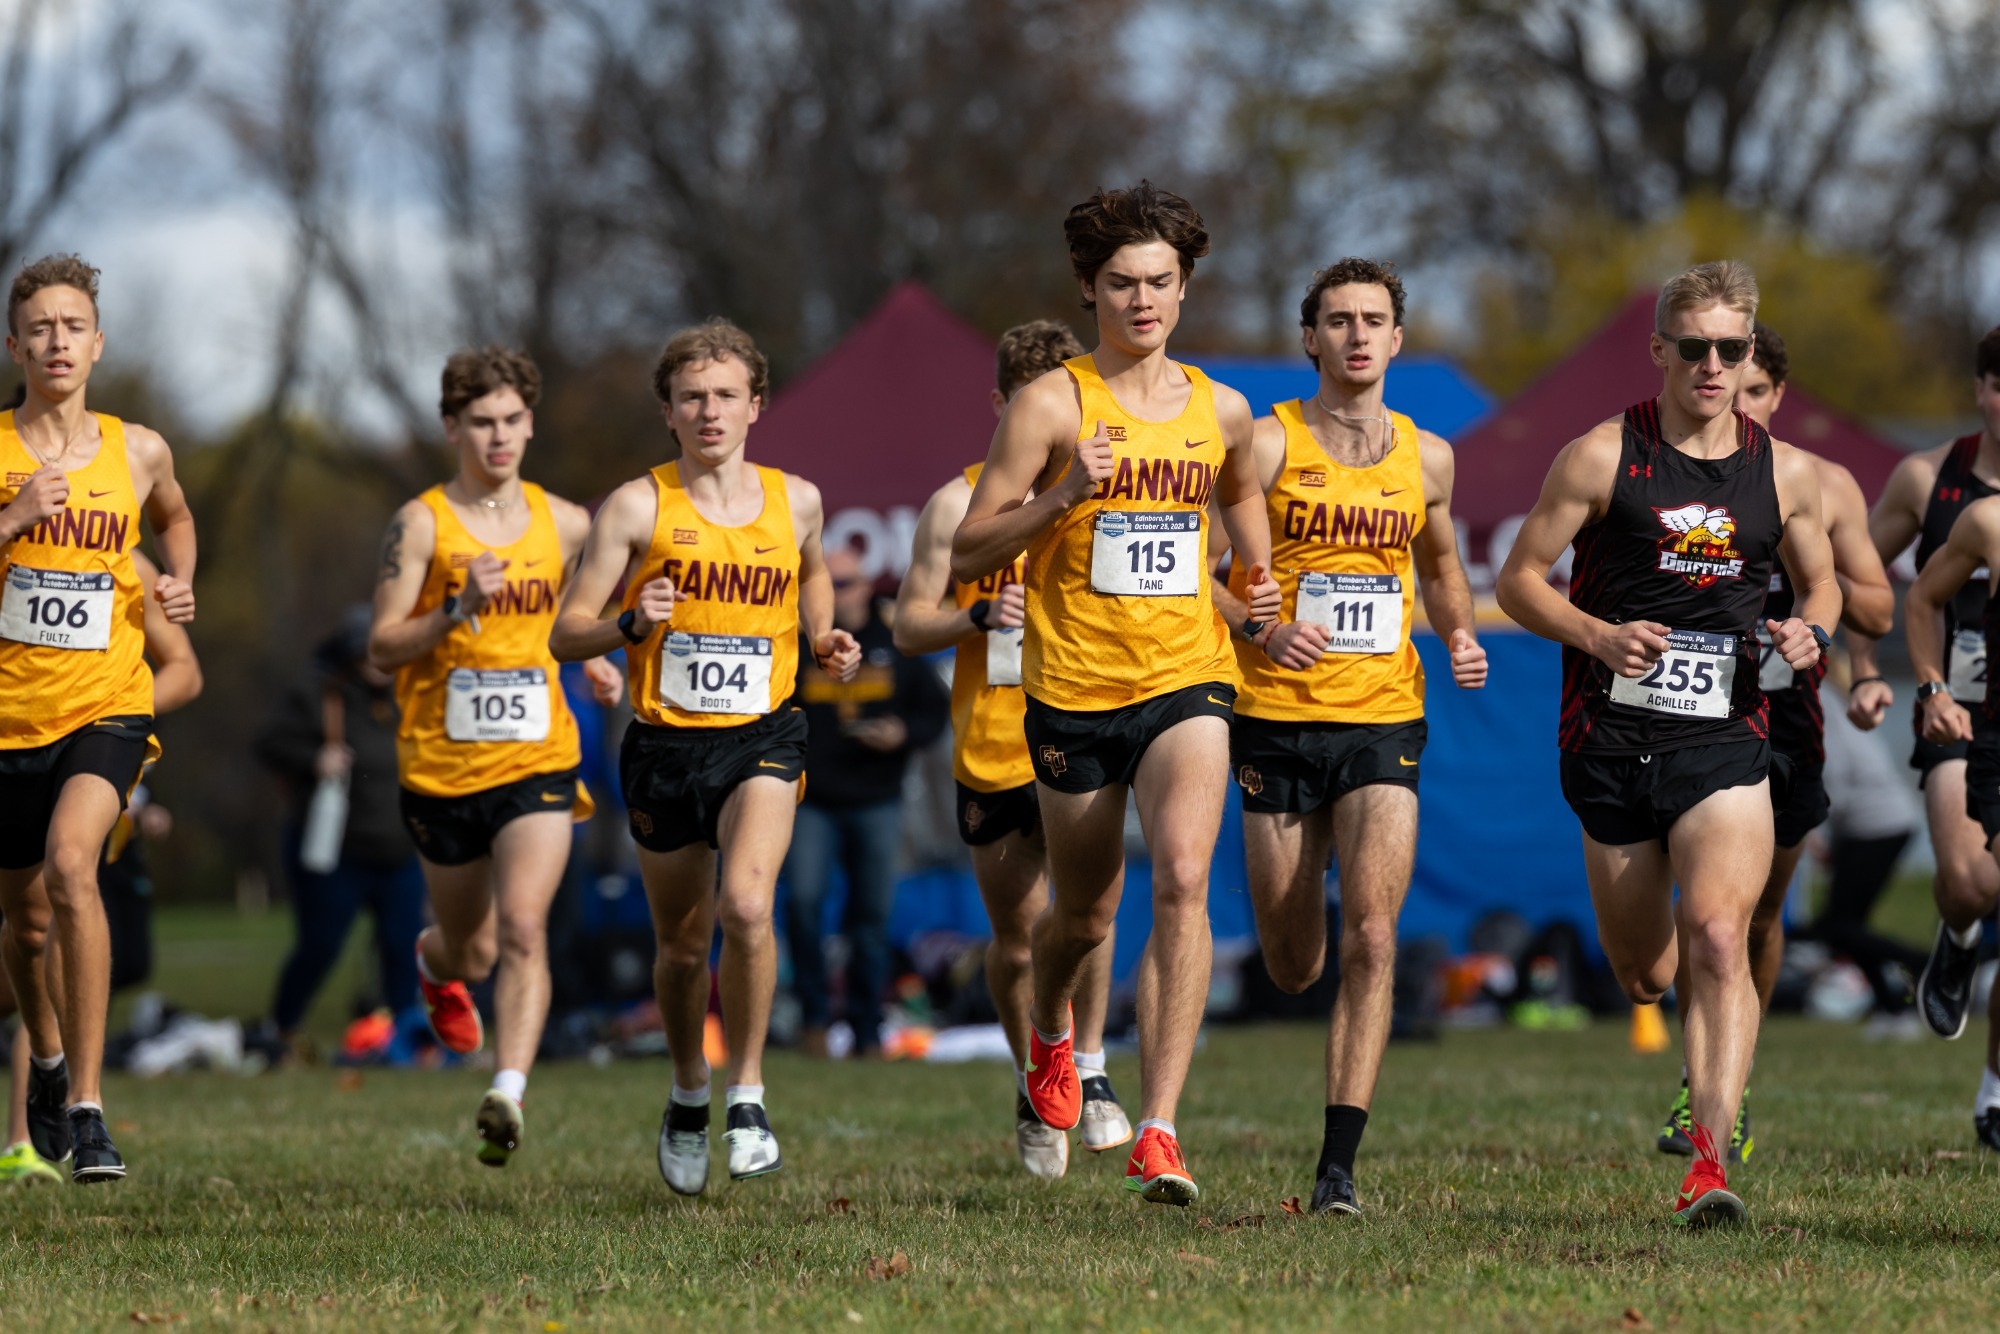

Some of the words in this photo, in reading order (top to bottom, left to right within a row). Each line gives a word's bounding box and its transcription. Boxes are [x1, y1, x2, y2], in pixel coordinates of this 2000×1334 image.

[1106, 430, 1127, 438] SAC
[1134, 514, 1165, 523] Edinboro,
[1134, 522, 1160, 530] October
[1284, 500, 1416, 551] GANNON
[1126, 540, 1176, 573] 115
[1657, 550, 1745, 577] GRIFFINS
[1138, 578, 1163, 590] TANG
[27, 595, 89, 629] 106
[1333, 600, 1374, 632] 111
[39, 630, 70, 644] FULTZ
[1695, 635, 1705, 643] PA
[1700, 644, 1718, 653] 2025
[686, 660, 748, 693] 104
[1637, 657, 1714, 695] 255
[470, 695, 526, 721] 105
[700, 696, 732, 709] BOOTS
[1646, 692, 1698, 712] ACHILLES
